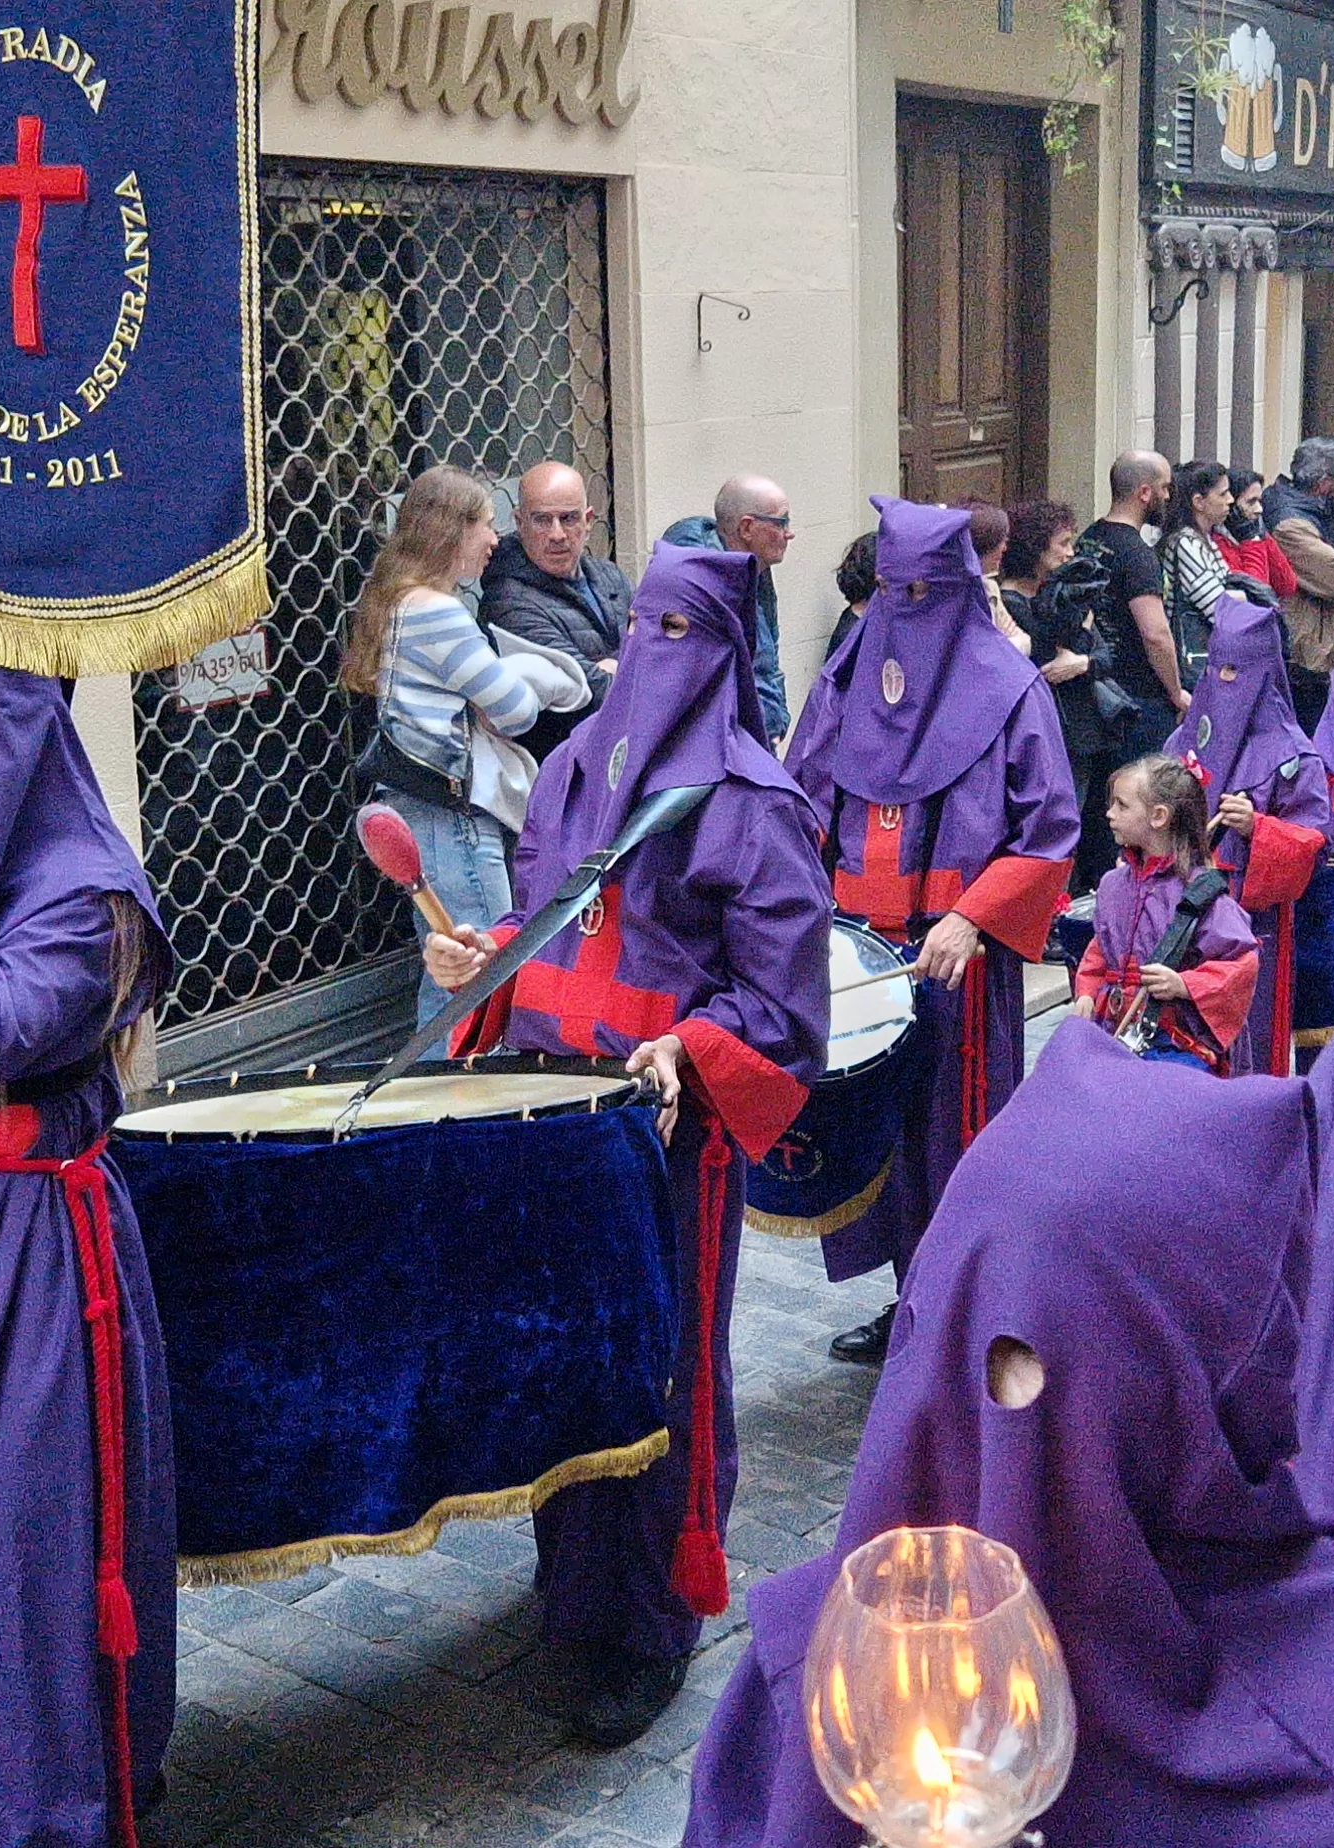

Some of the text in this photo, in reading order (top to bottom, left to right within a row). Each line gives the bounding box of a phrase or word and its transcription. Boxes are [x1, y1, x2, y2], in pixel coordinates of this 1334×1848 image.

[31, 401, 81, 442] LA
[75, 170, 150, 413] ESPERANZA
[46, 448, 124, 489] 2011
